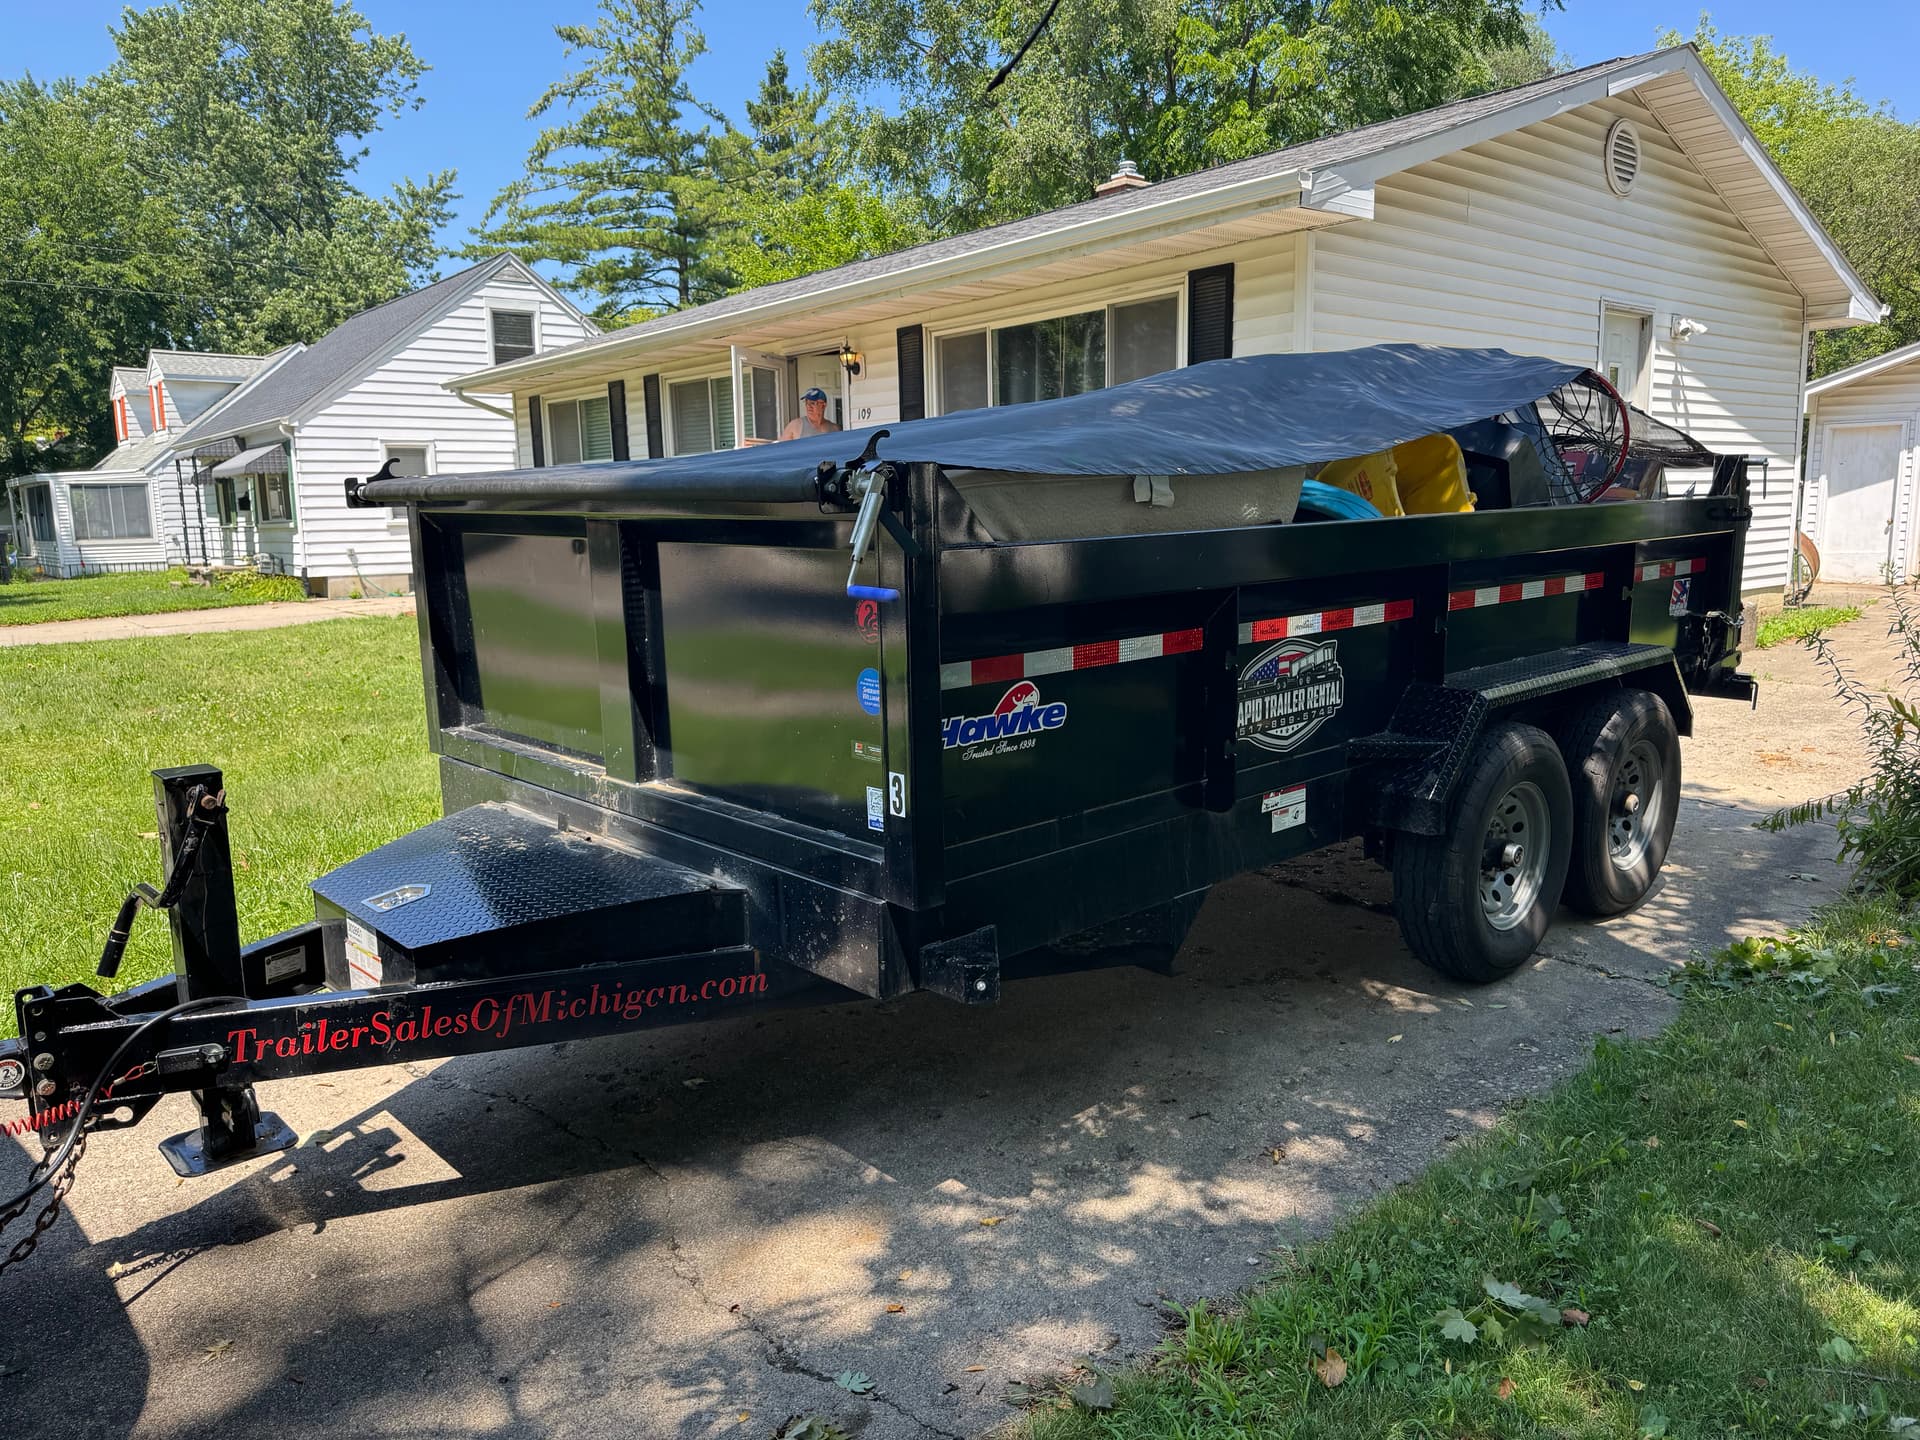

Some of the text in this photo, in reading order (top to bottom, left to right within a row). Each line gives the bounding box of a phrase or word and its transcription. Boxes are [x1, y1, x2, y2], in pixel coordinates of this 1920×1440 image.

[858, 408, 872, 420] 109
[1237, 681, 1341, 728] APID TRAILER RENTAL
[942, 702, 1067, 749] Hawke
[962, 744, 994, 760] Trusted
[995, 740, 1018, 754] Since
[892, 775, 903, 815] 3
